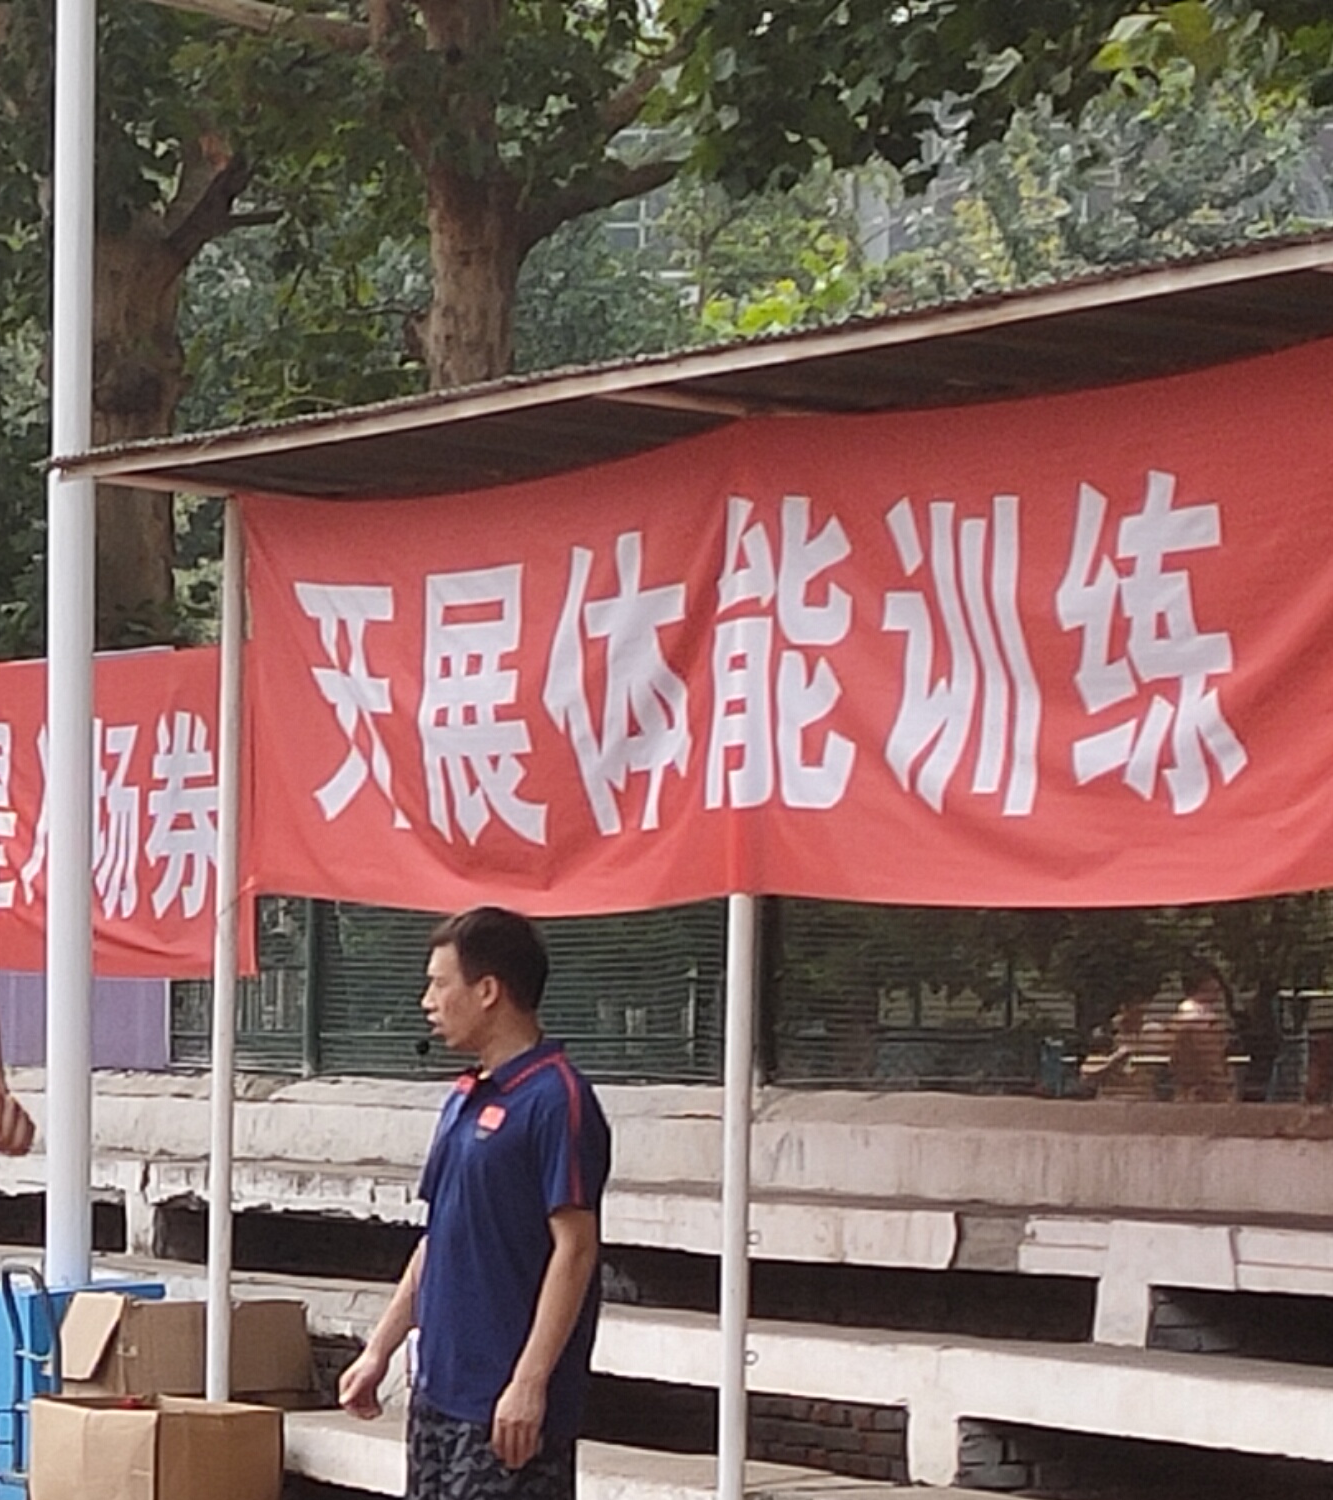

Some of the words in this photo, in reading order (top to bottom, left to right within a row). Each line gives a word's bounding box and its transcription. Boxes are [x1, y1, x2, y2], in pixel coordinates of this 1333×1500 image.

[293, 470, 1248, 846] 开展体能训练
